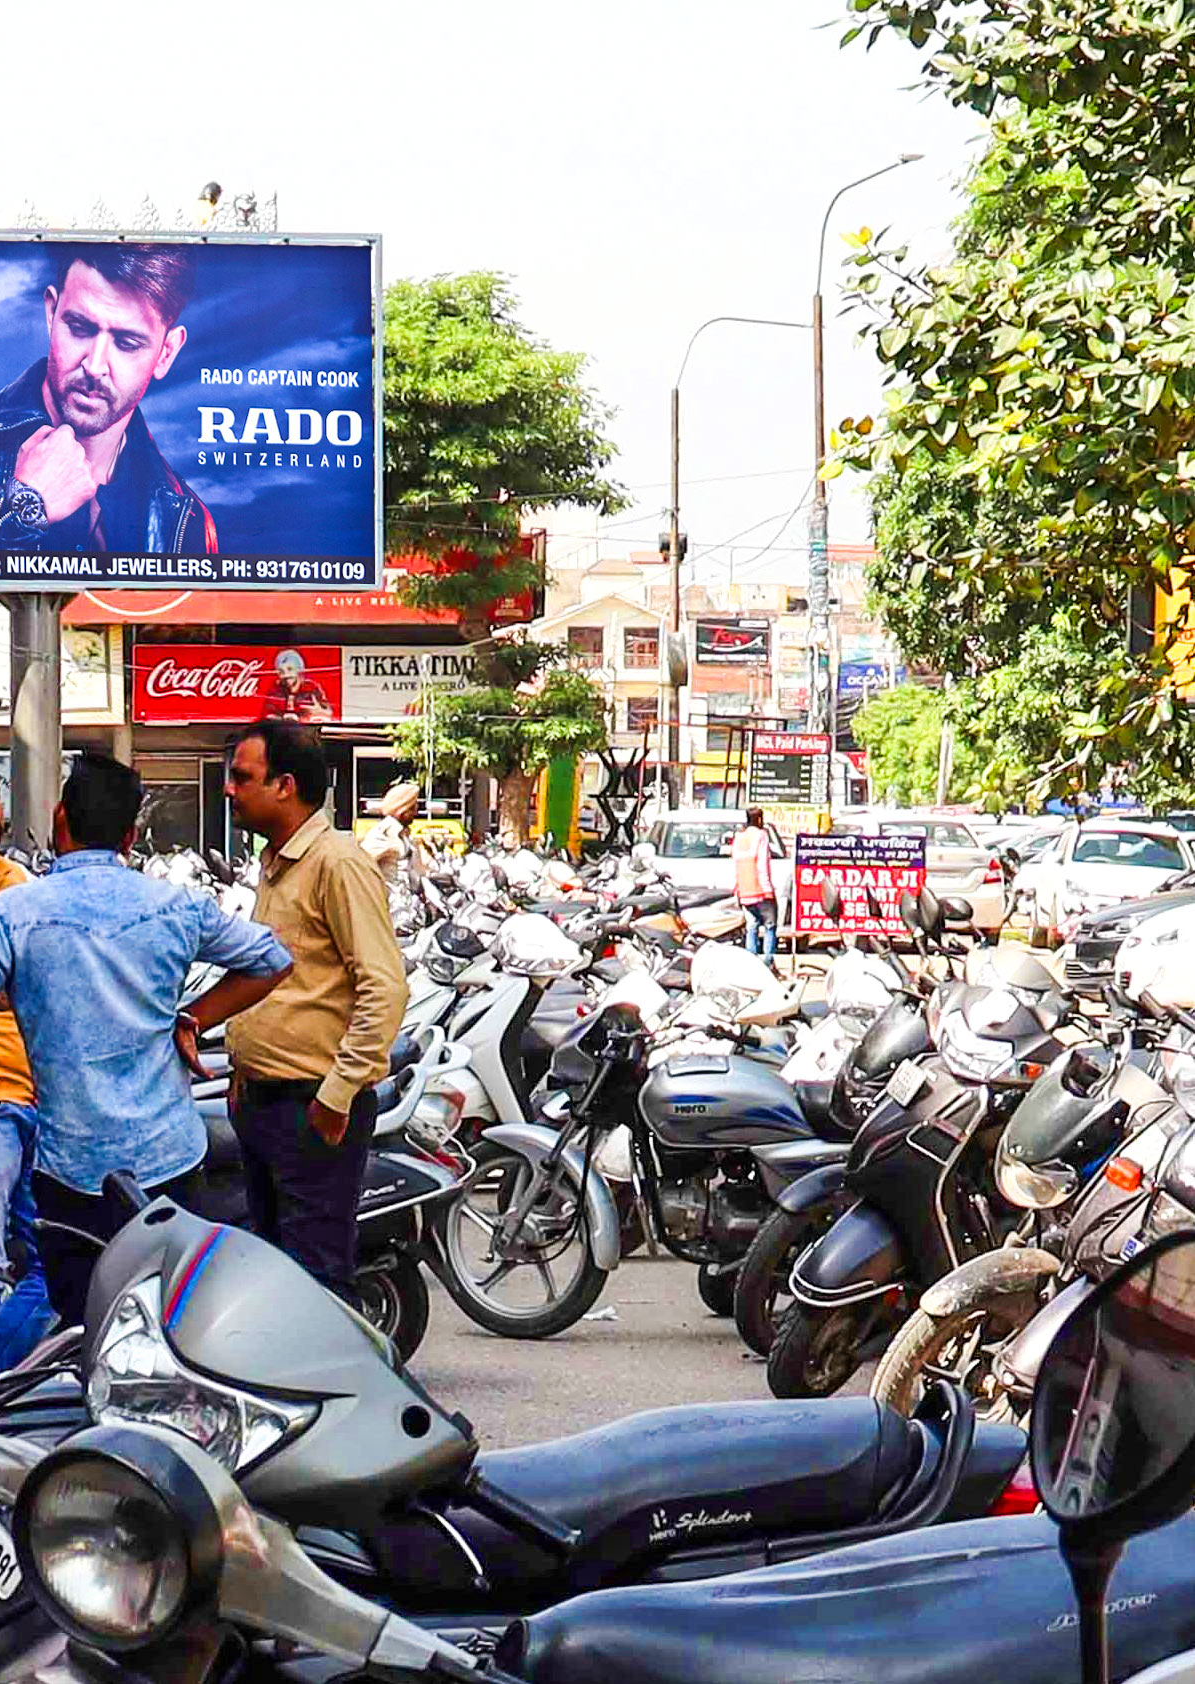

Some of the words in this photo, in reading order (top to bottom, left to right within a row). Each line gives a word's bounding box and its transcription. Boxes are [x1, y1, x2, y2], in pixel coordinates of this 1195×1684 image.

[200, 368, 243, 385] RADO
[247, 369, 313, 387] CAPTAIN
[316, 371, 359, 388] COOK
[197, 406, 363, 446] RADO
[197, 450, 363, 469] SWITZERLAND
[6, 556, 102, 575] NIKKAMAL
[107, 558, 218, 580] JEWELLERS,
[222, 560, 252, 577] PH:
[256, 560, 365, 580] 9317610109
[332, 598, 362, 606] LIVE
[350, 655, 418, 677] TIKKA
[800, 868, 894, 888] SARDAR
[897, 870, 919, 889] JI
